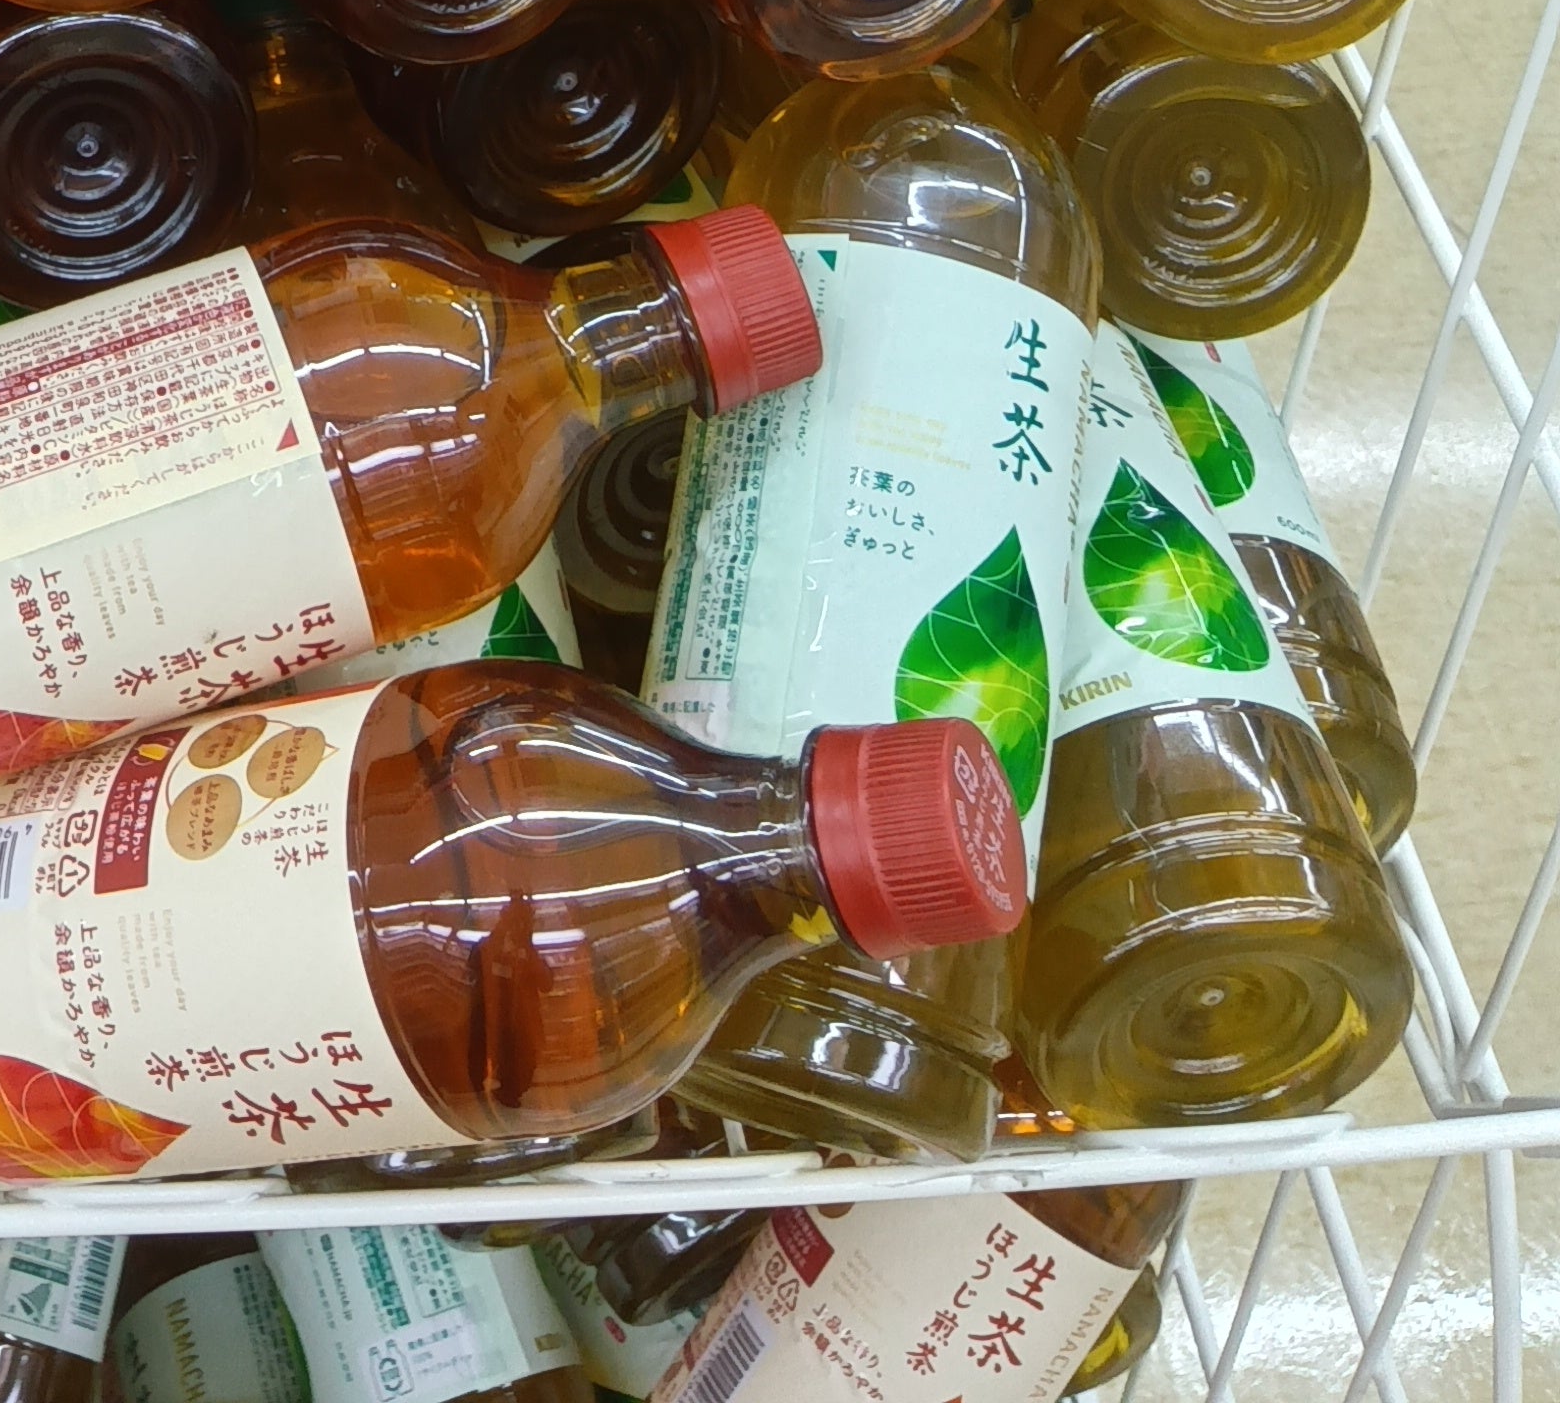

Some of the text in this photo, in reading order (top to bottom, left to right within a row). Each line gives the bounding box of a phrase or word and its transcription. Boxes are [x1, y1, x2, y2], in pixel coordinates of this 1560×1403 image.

[77, 398, 285, 478] よくふってからお飲みください。
[992, 319, 1053, 486] 生茶
[844, 526, 915, 561] ぎゅっと
[845, 499, 936, 536] おいしさ、
[9, 576, 61, 698] 余韻かろやか
[39, 566, 89, 681] 上品な香り、
[114, 603, 333, 697] ほうじ煎茶
[178, 639, 346, 710] 生茶
[1060, 671, 1133, 710] KIRIN
[131, 774, 158, 862] 茶葉の味わい
[273, 840, 330, 878] 生茶
[46, 862, 56, 892] PET
[54, 923, 96, 1069] 余韻かろやか
[80, 919, 115, 1052] 上品な香り、
[147, 1031, 363, 1092] ほうじ煎茶
[223, 1080, 394, 1144] 生茶
[904, 1221, 1007, 1377] ほうじ煎茶
[966, 1254, 1059, 1375] 生茶
